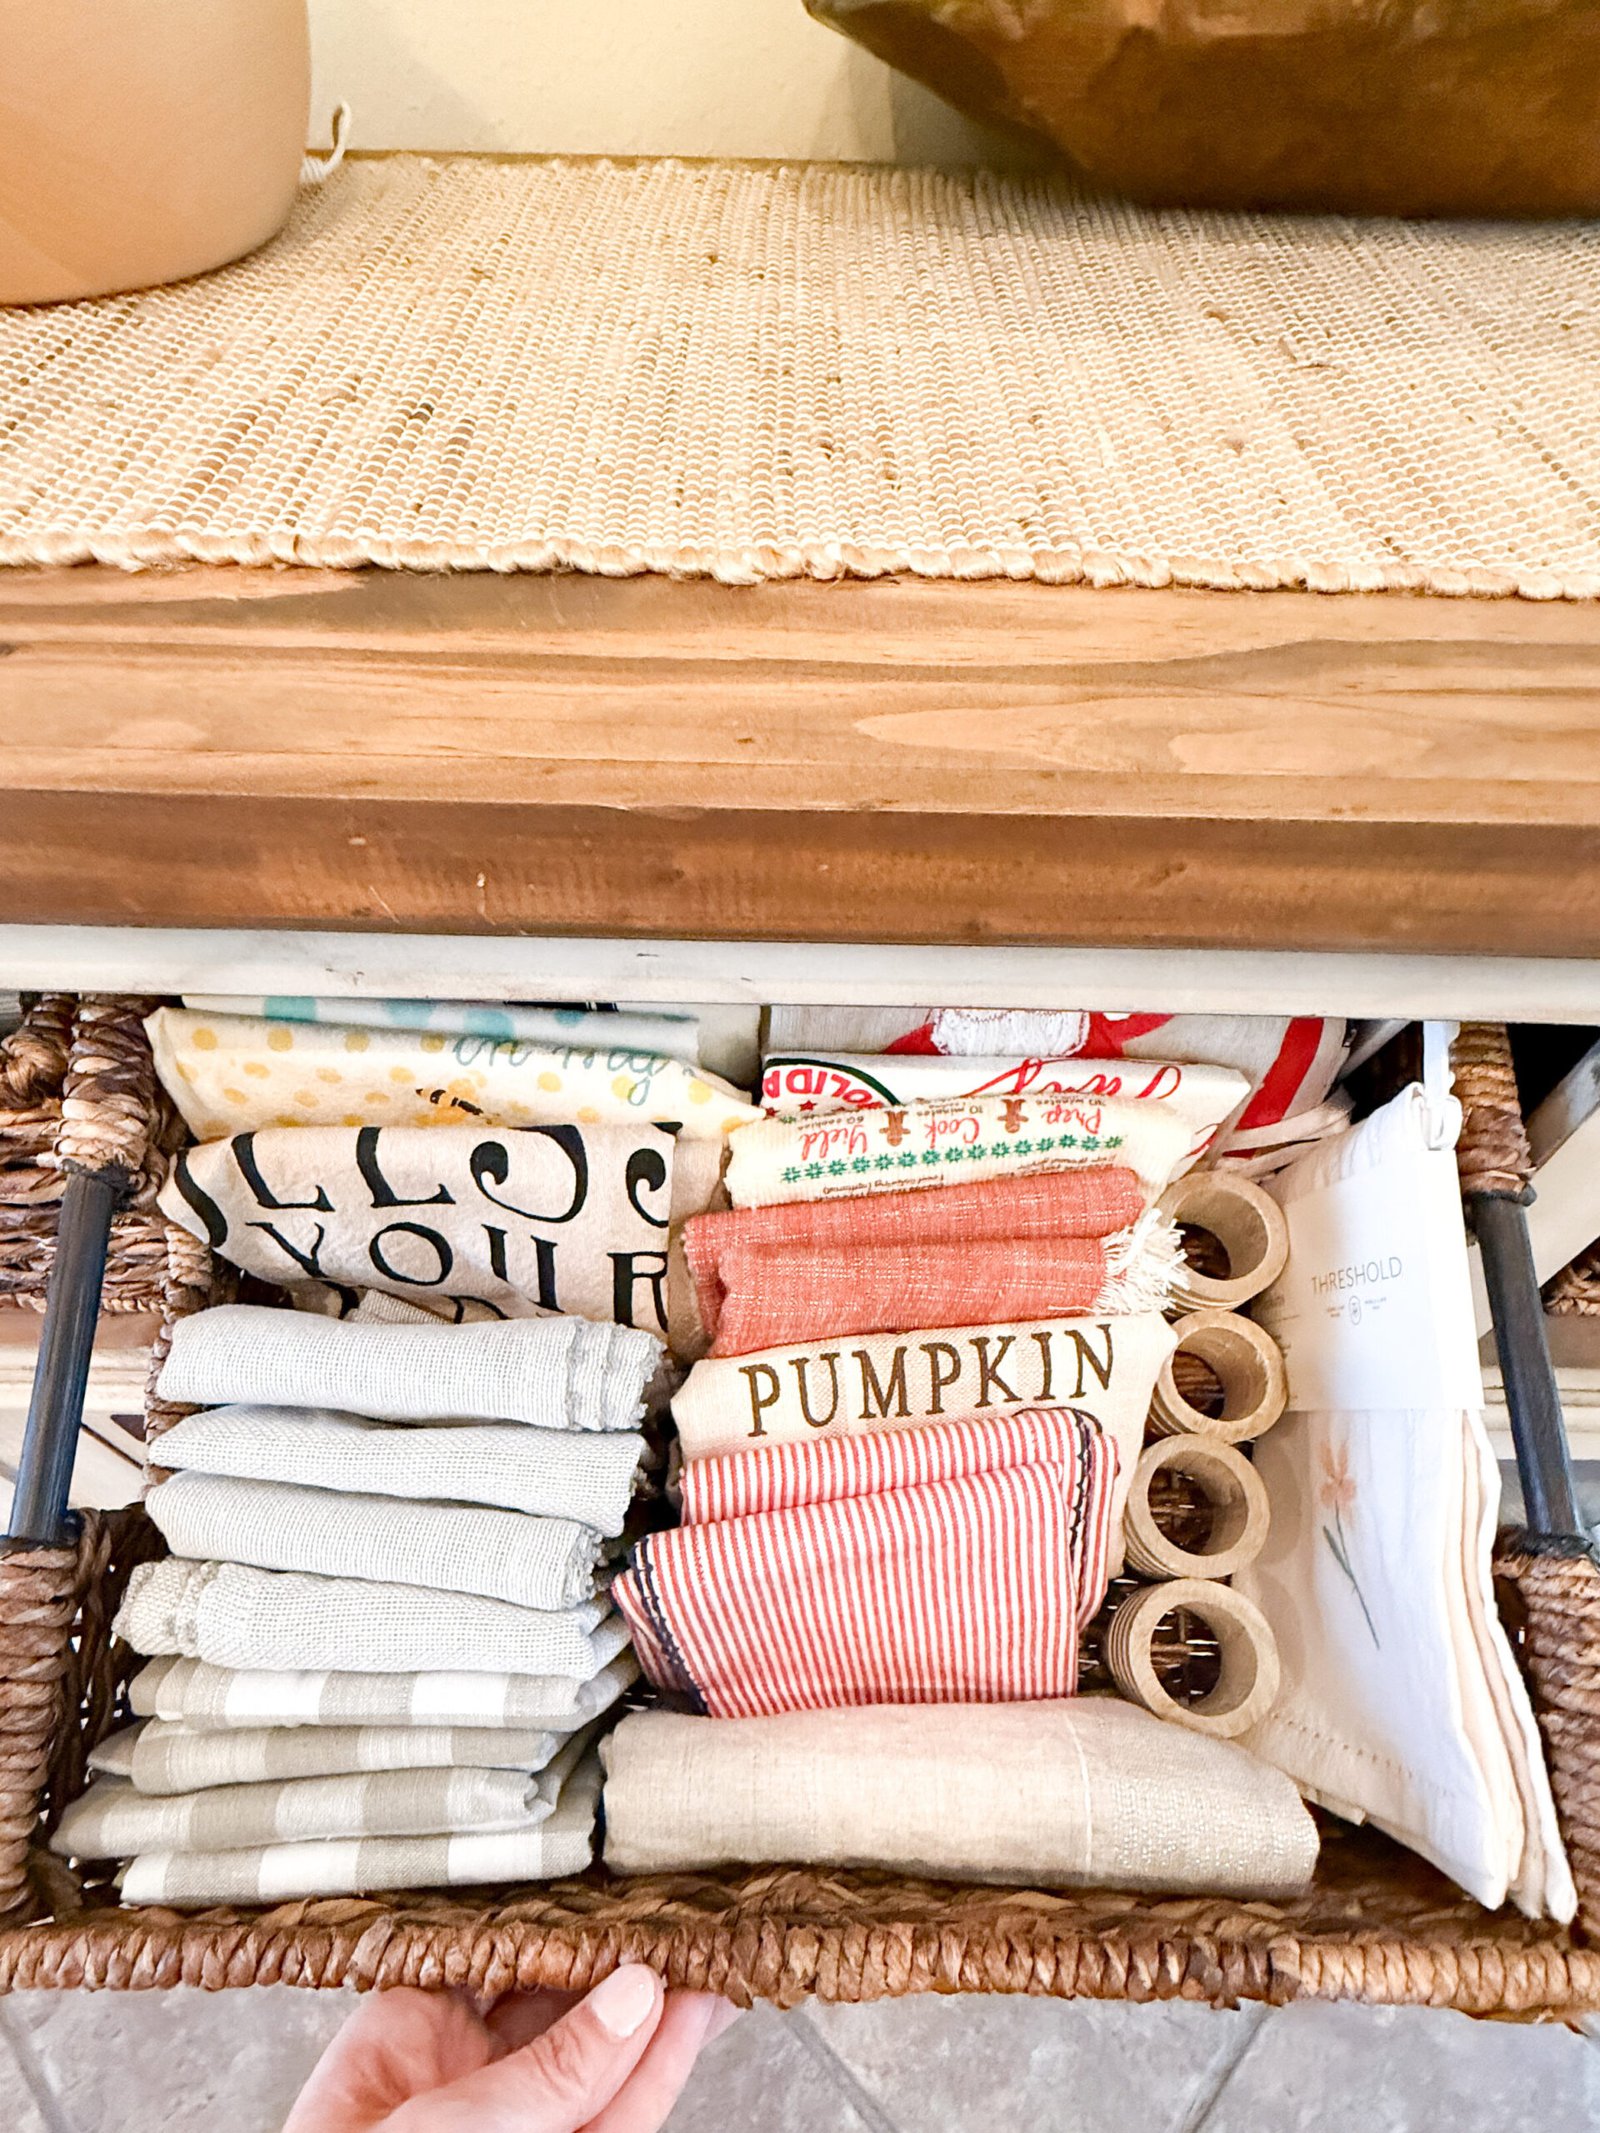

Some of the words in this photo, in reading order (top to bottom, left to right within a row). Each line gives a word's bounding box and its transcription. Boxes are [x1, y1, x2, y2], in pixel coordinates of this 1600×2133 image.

[925, 1113, 980, 1149] Cook
[1041, 1104, 1102, 1135] Prep
[800, 1124, 868, 1161] Yield
[1311, 1256, 1403, 1295] THRESHOLD
[738, 1323, 1112, 1437] PUMPKIN
